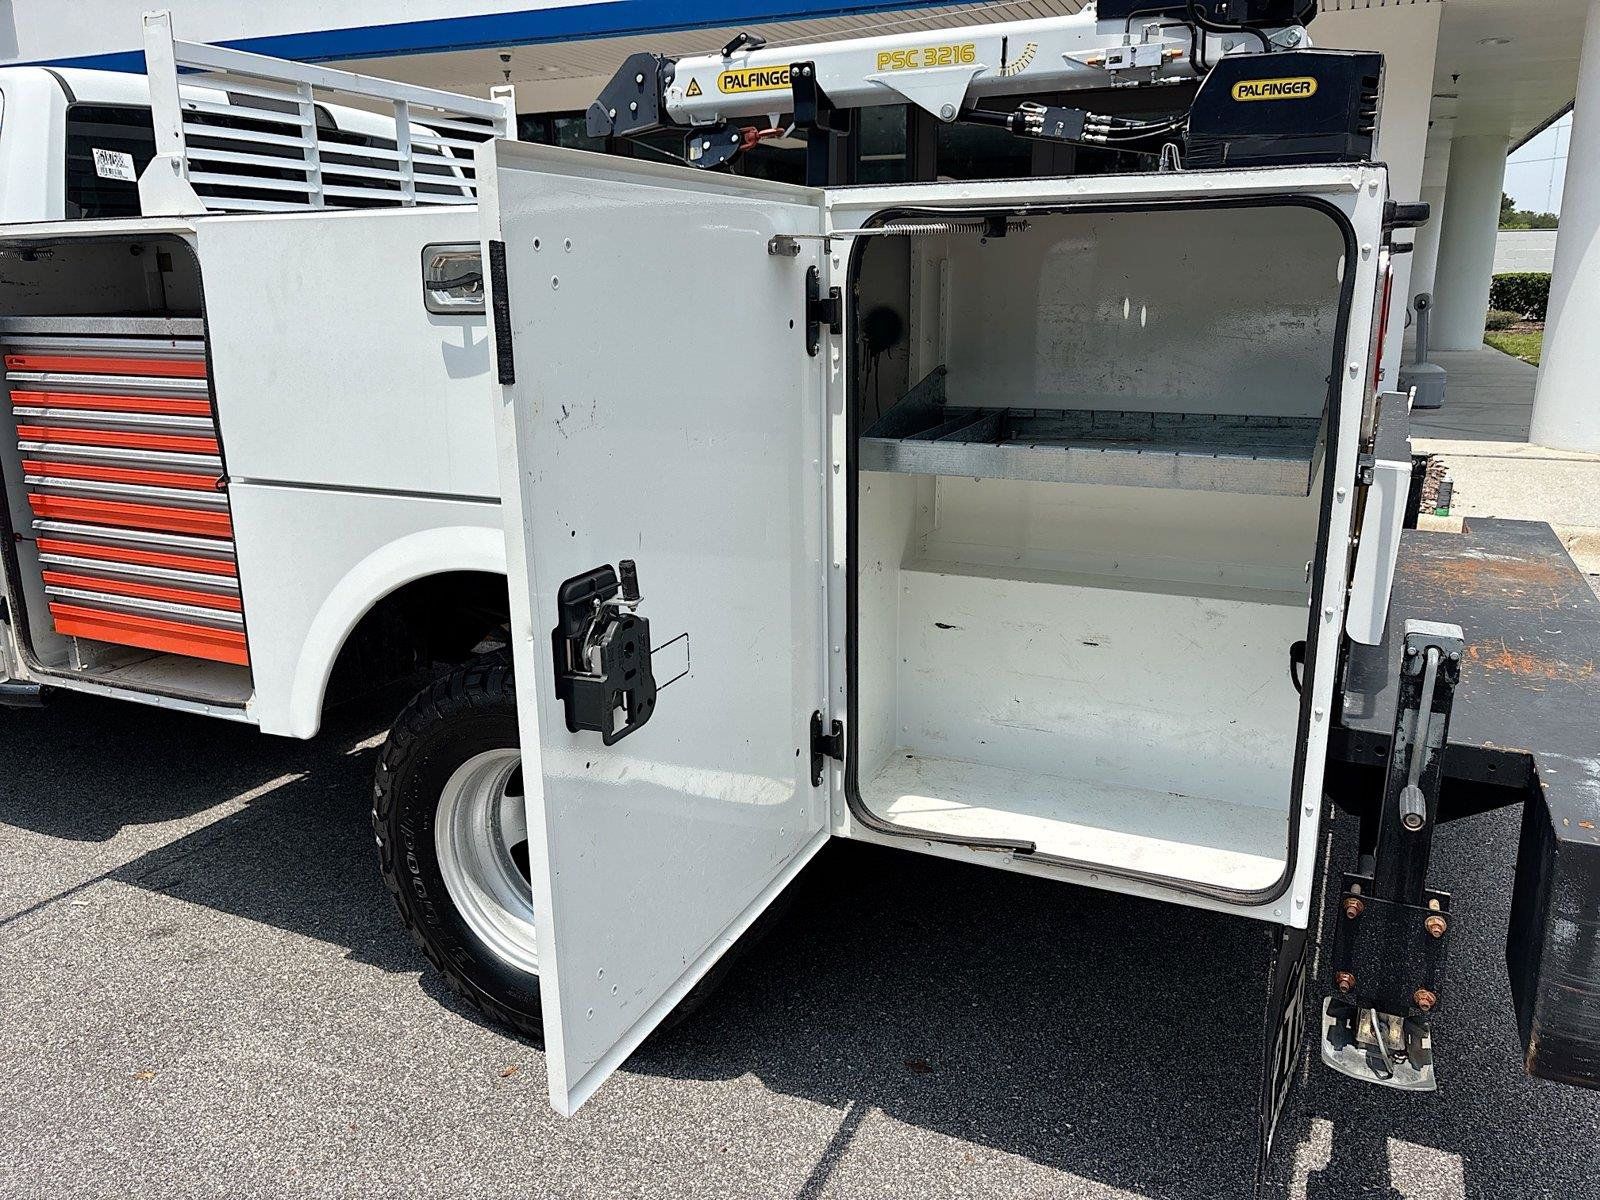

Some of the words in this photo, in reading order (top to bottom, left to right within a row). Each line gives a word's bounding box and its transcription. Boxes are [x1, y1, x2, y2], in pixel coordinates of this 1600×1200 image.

[877, 49, 919, 71] PSC
[923, 43, 976, 67] 3216
[723, 69, 793, 90] PALFINGE
[1238, 81, 1311, 98] PALFINGER
